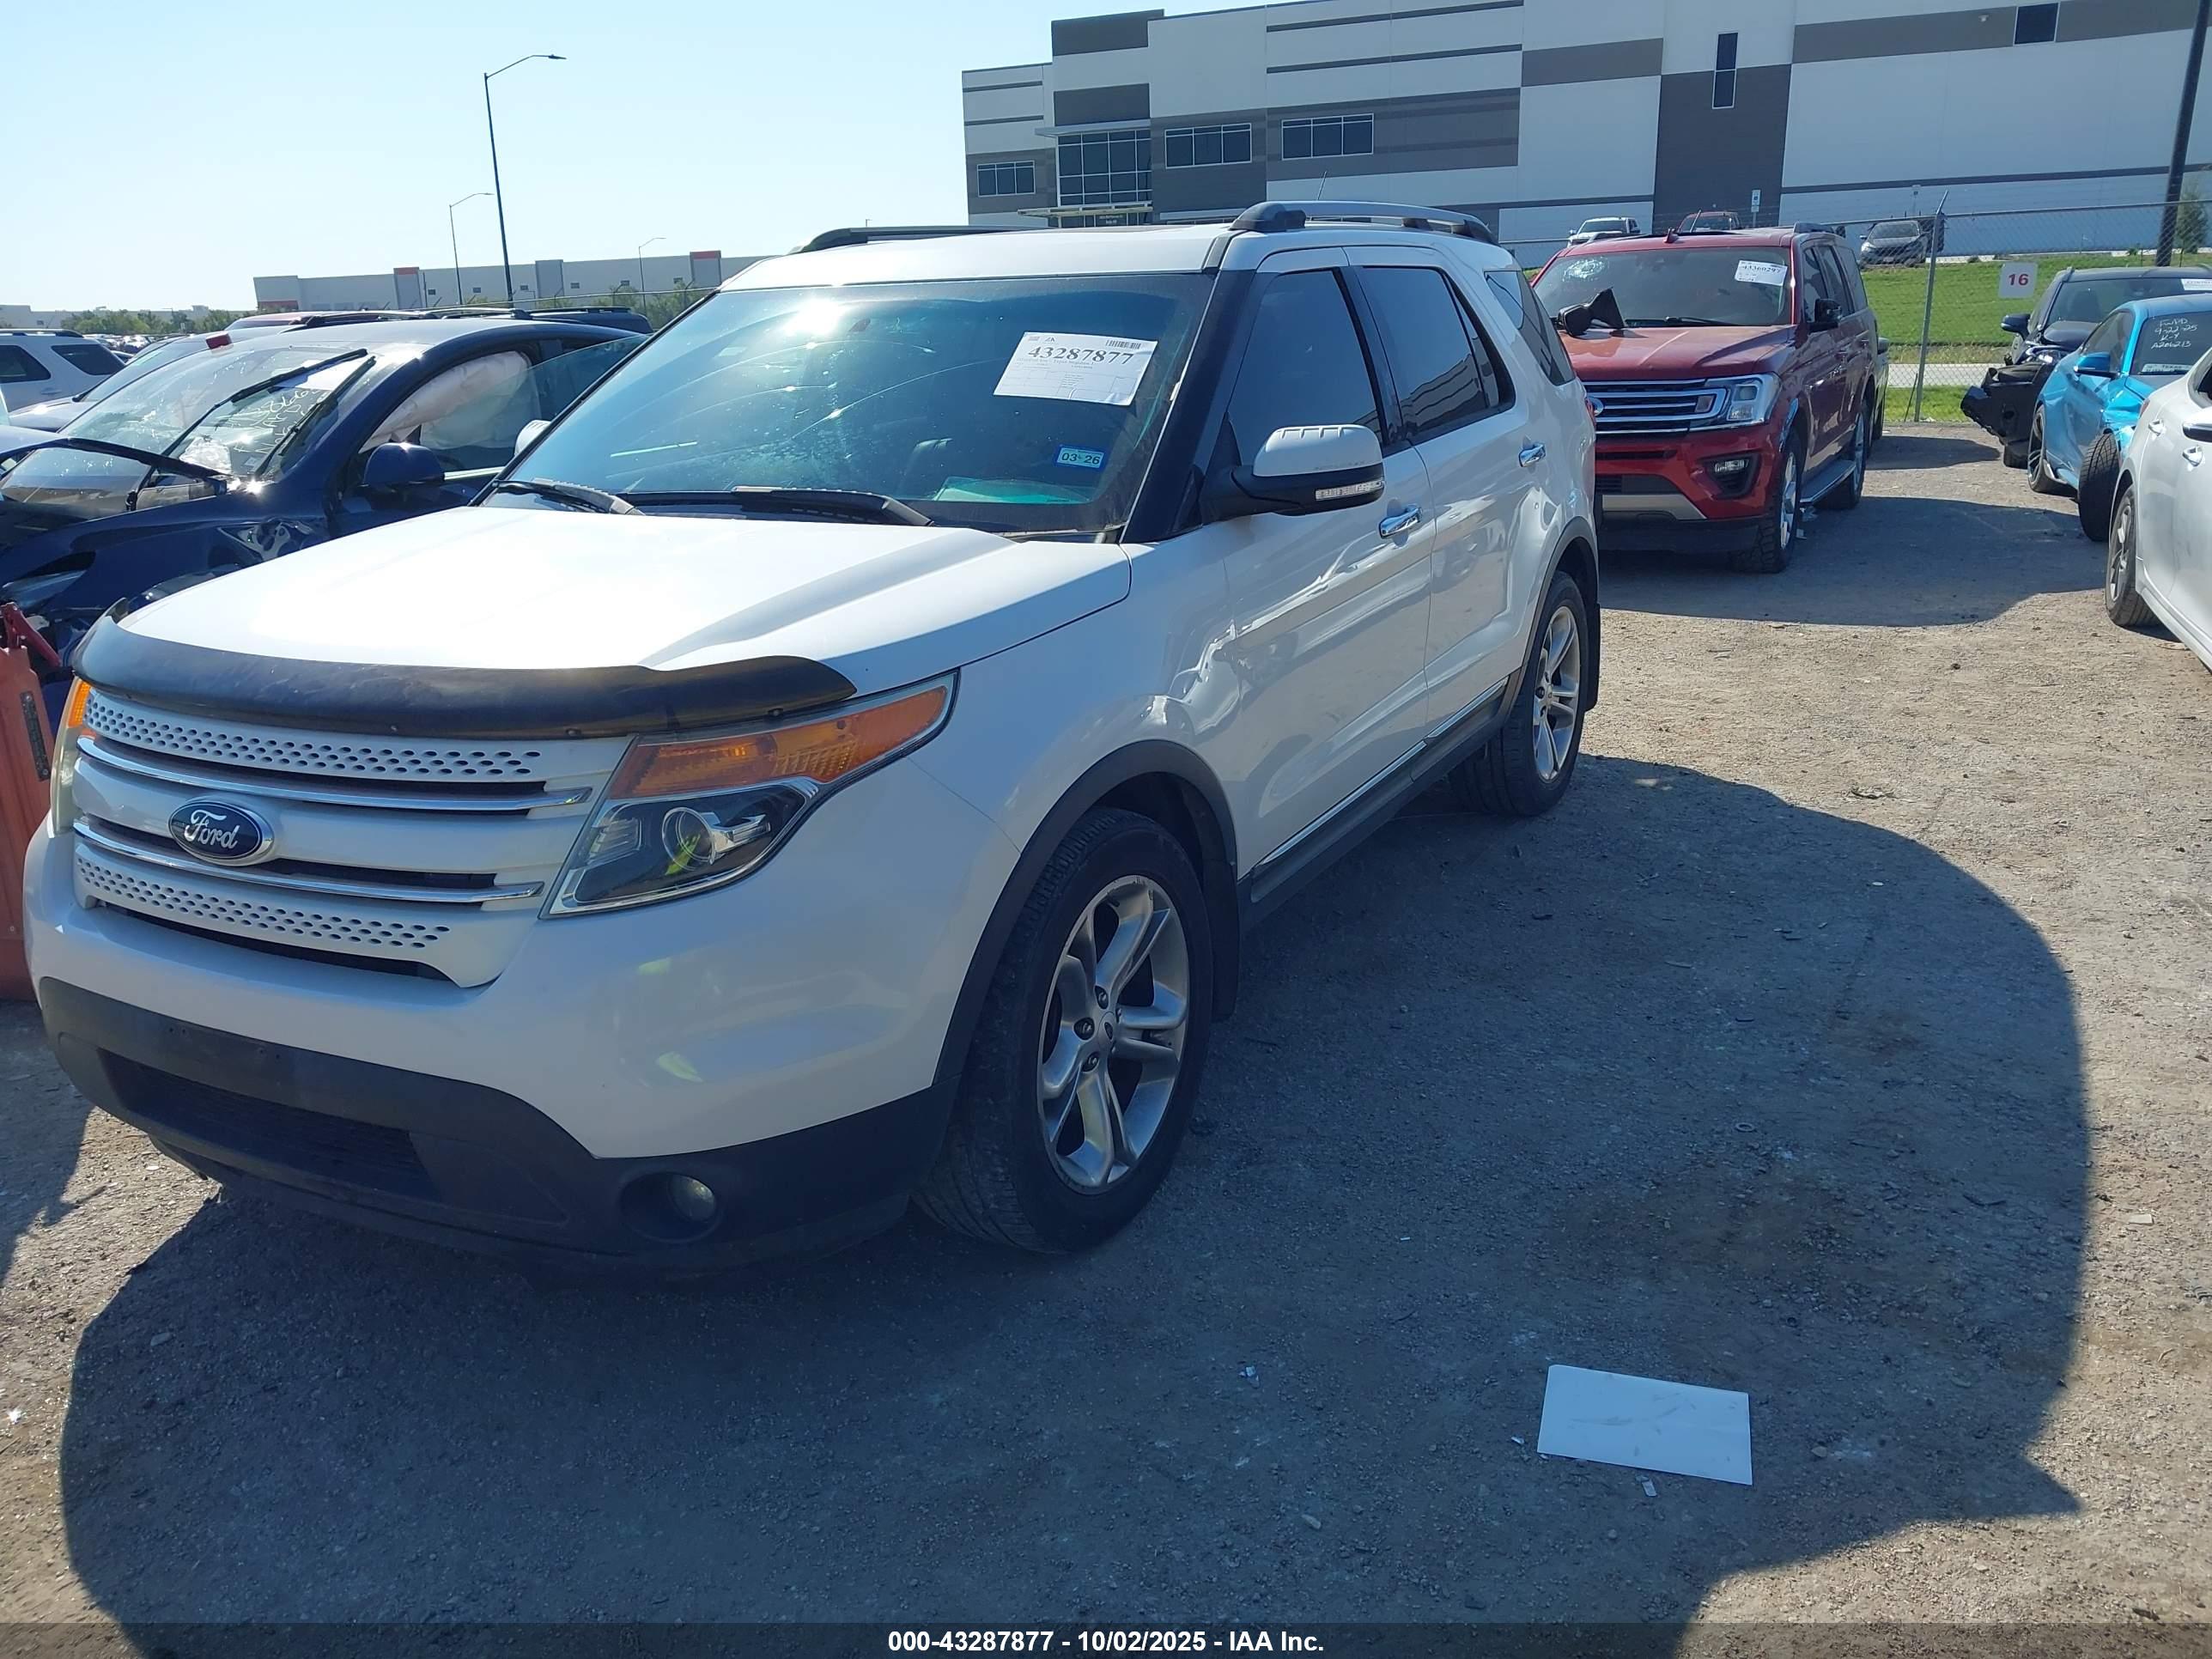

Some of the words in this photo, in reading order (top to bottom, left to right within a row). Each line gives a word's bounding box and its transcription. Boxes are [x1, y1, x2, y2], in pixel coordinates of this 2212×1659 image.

[2008, 273, 2029, 286] 16
[1028, 346, 1134, 365] 43287877
[1061, 453, 1078, 462] 03
[1084, 455, 1100, 465] 26
[184, 809, 240, 849] Ford
